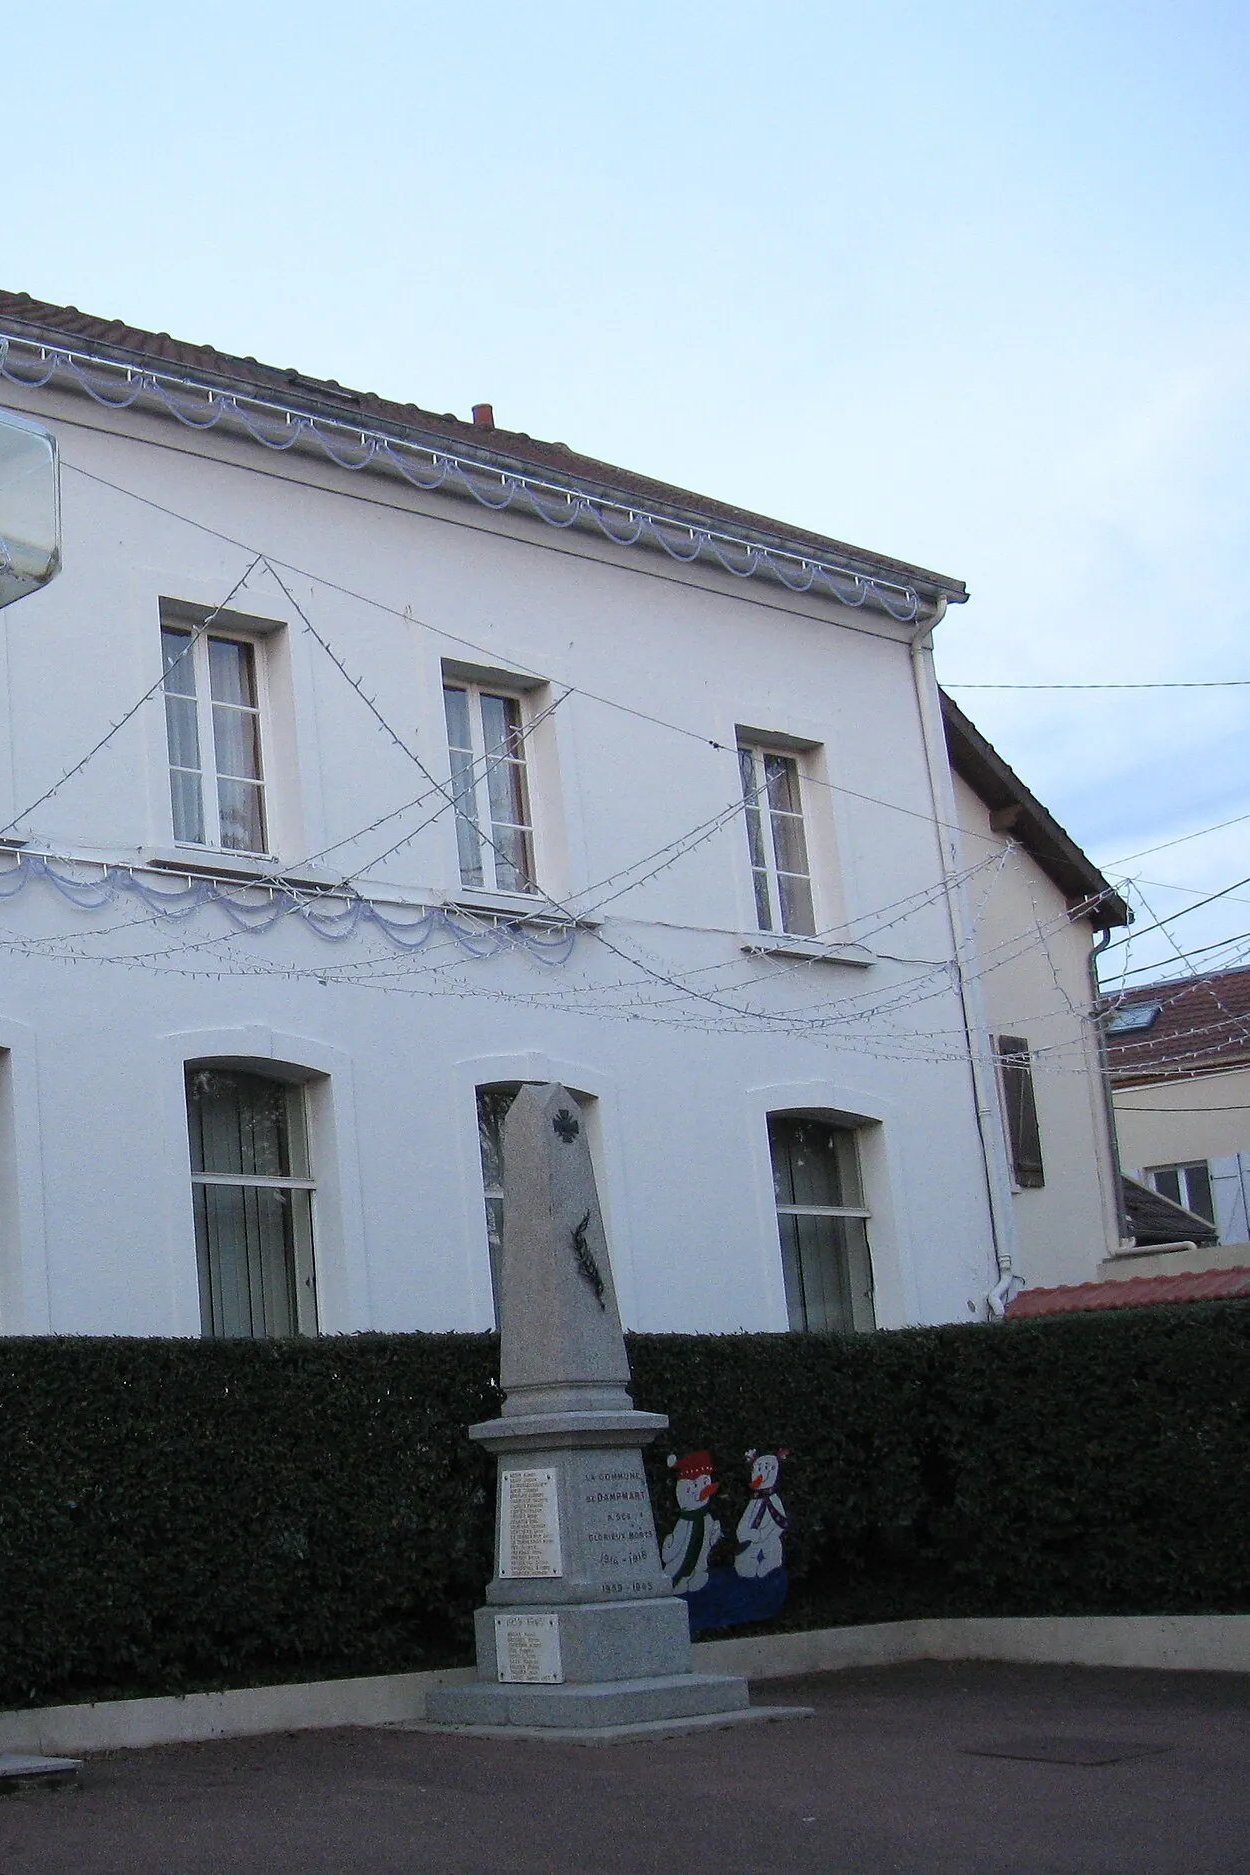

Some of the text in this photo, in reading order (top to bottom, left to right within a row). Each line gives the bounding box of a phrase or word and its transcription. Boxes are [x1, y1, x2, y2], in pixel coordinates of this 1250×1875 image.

[585, 1472, 641, 1481] LA COMMUNE
[597, 1491, 645, 1502] DAMPMART
[588, 1530, 653, 1542] GLORIEUX MORTS
[629, 1550, 648, 1564] 1918
[601, 1583, 623, 1594] 1939
[632, 1582, 654, 1592] 1945
